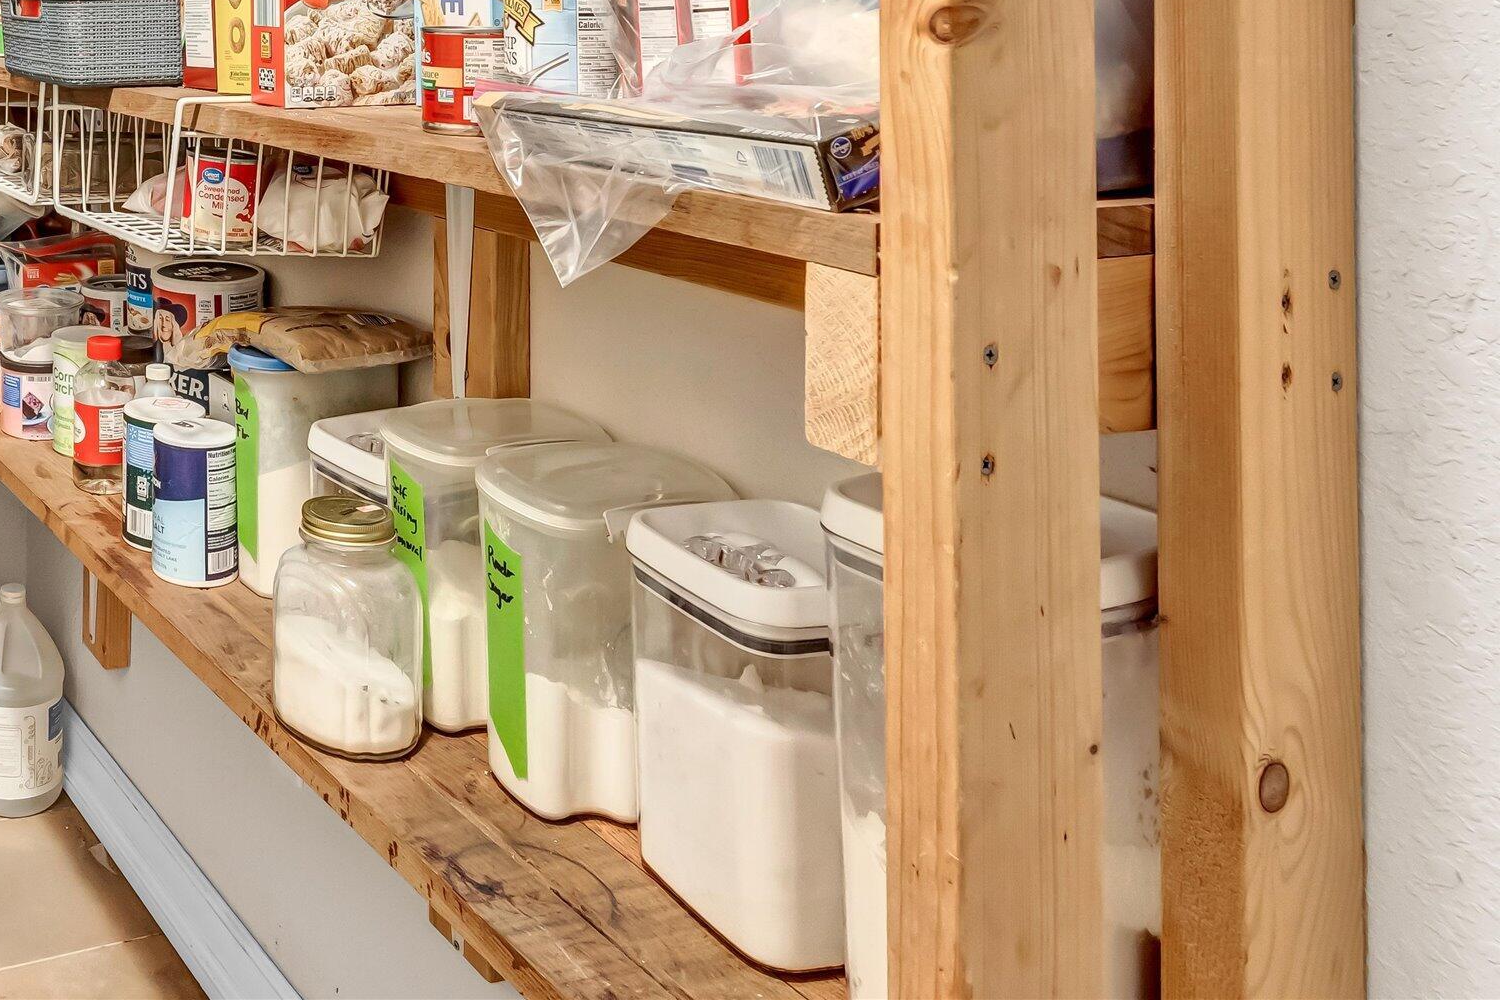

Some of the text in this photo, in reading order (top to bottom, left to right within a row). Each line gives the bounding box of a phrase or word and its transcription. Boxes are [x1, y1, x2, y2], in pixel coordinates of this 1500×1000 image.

[204, 184, 241, 195] Sweetned
[212, 201, 229, 211] Mil
[126, 272, 148, 290] ITS
[54, 366, 74, 381] Corn
[55, 381, 74, 395] arch
[208, 450, 232, 459] Nutrition
[208, 474, 229, 482] Calories
[392, 475, 407, 500] Self
[392, 496, 418, 535] Rising
